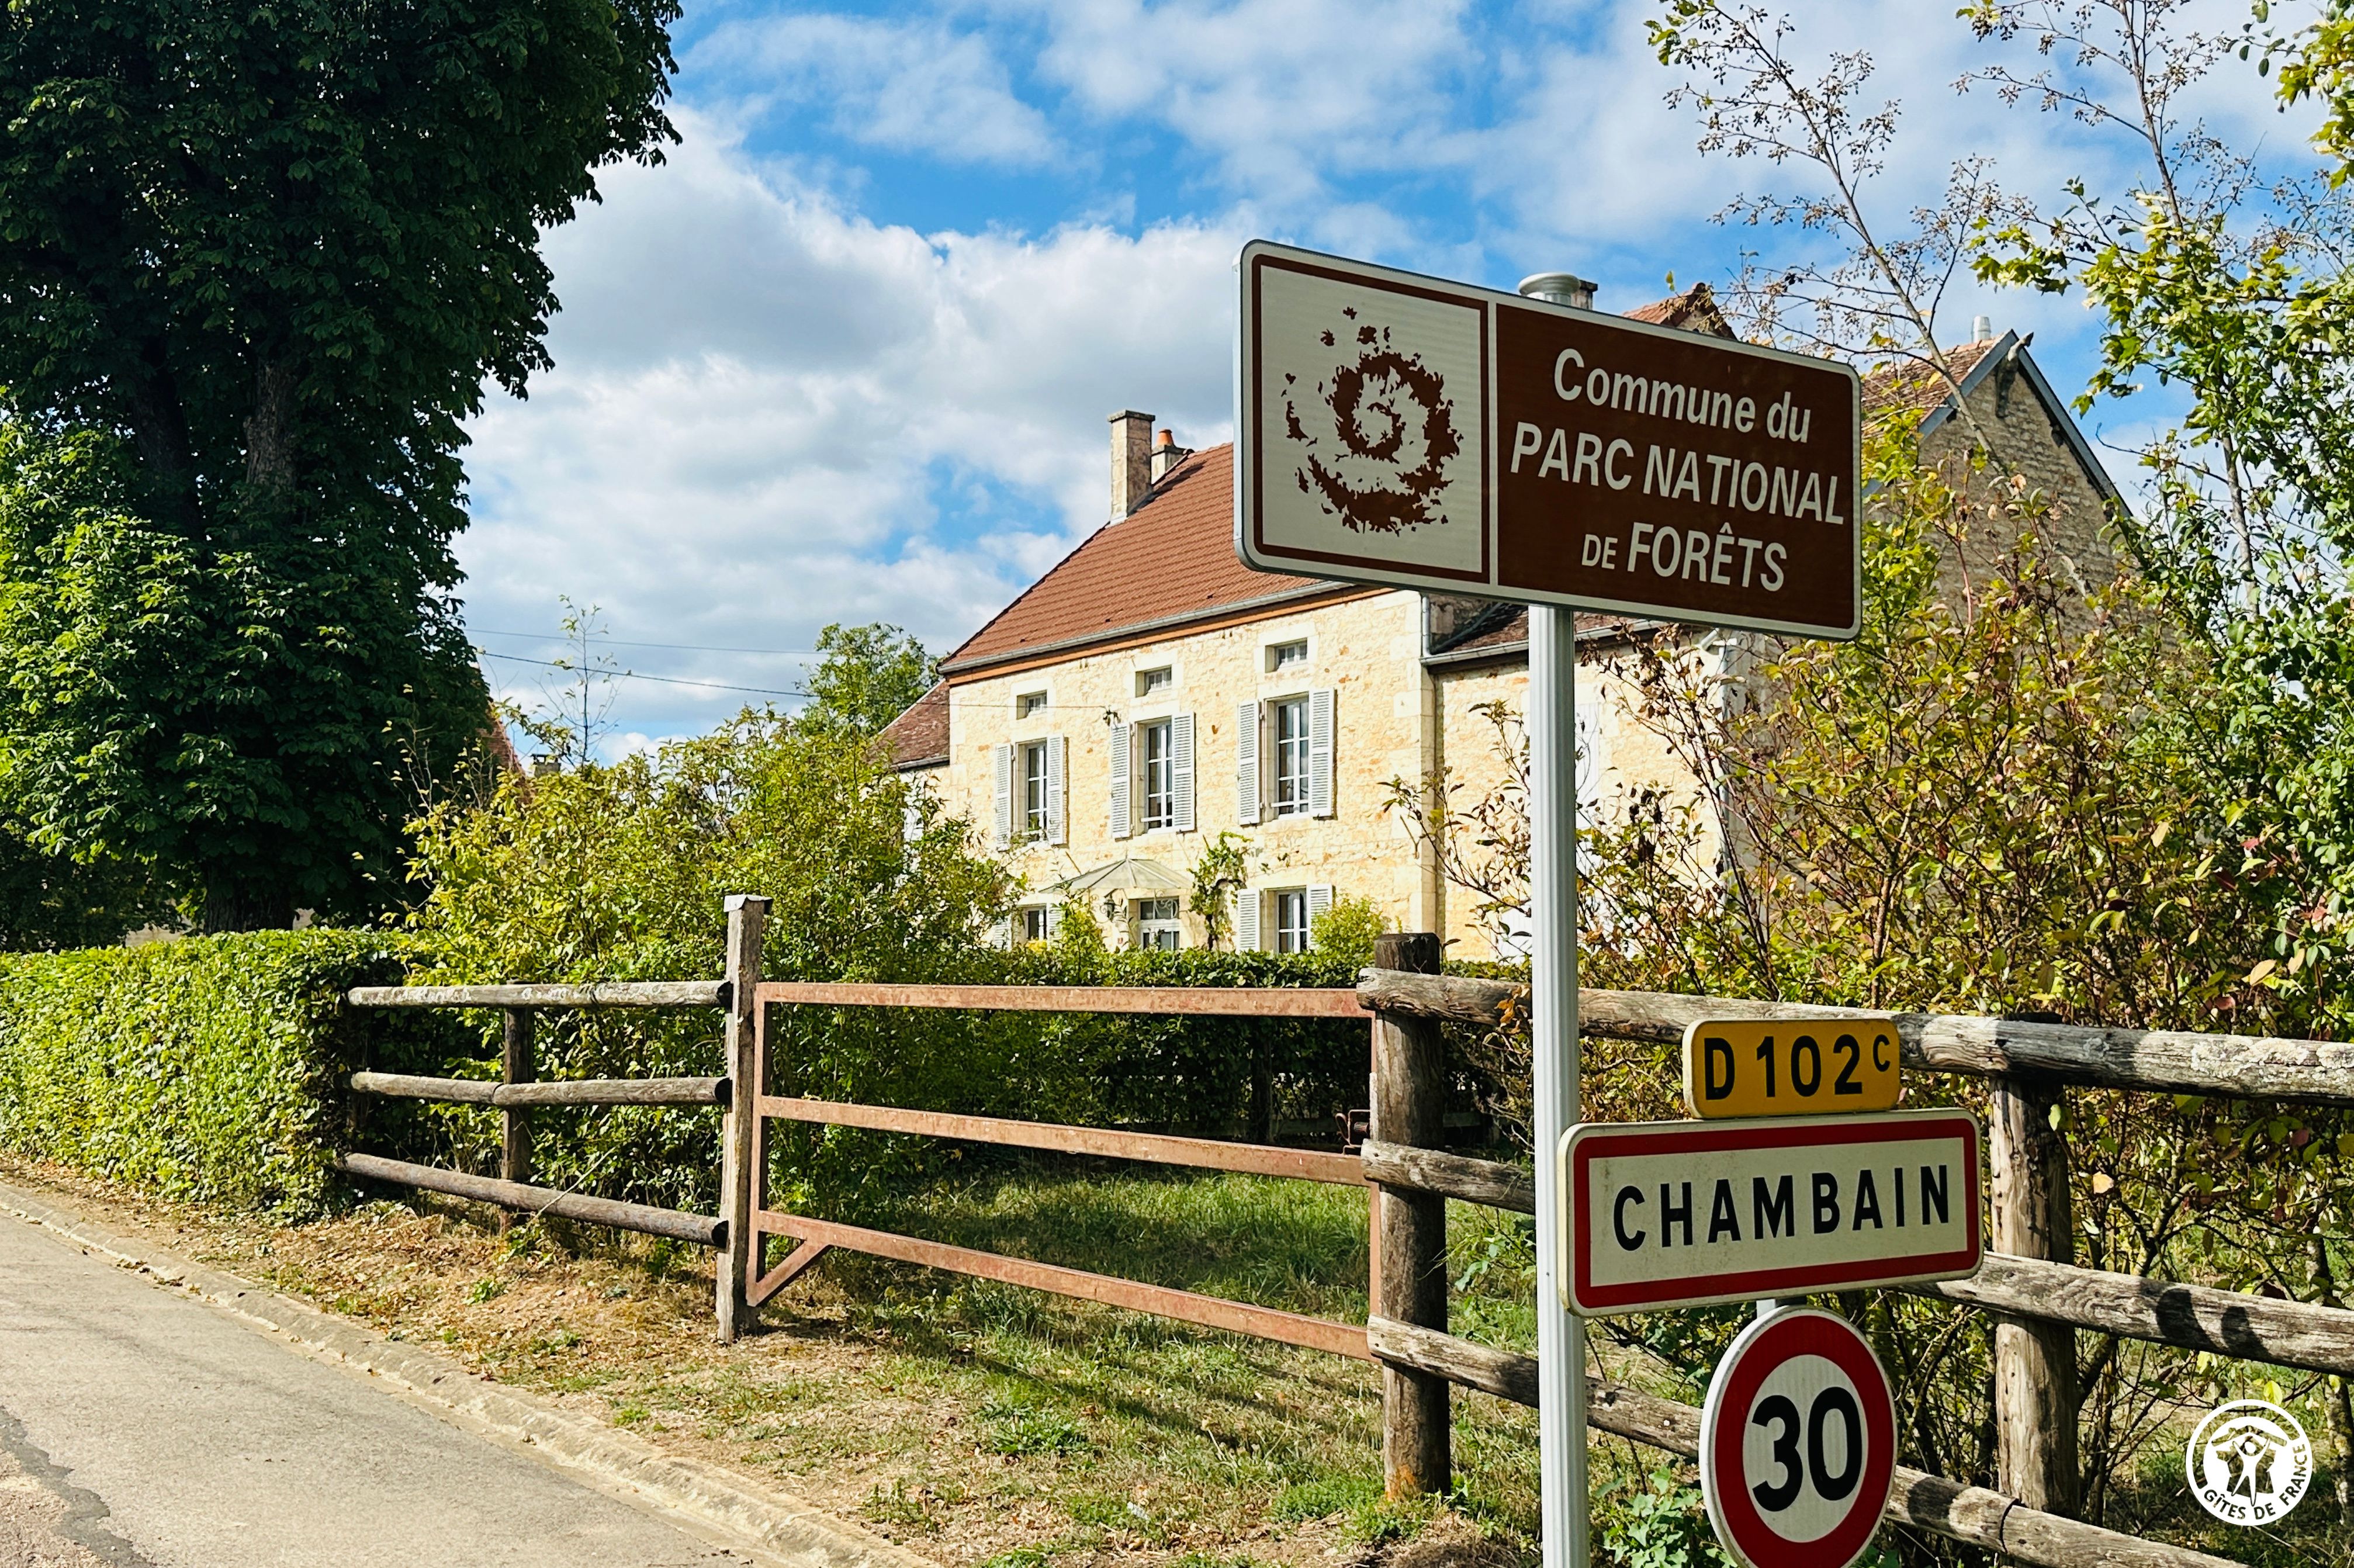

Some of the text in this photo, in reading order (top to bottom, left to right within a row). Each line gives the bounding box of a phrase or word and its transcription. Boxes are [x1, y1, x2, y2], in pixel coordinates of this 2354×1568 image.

[1553, 348, 1811, 444] Commune du
[1510, 422, 1845, 525] PARC NATIONAL
[1581, 522, 1788, 592] DE FORÊTS
[1612, 1164, 1950, 1252] CHAMBAIN
[1751, 1386, 1863, 1512] 30
